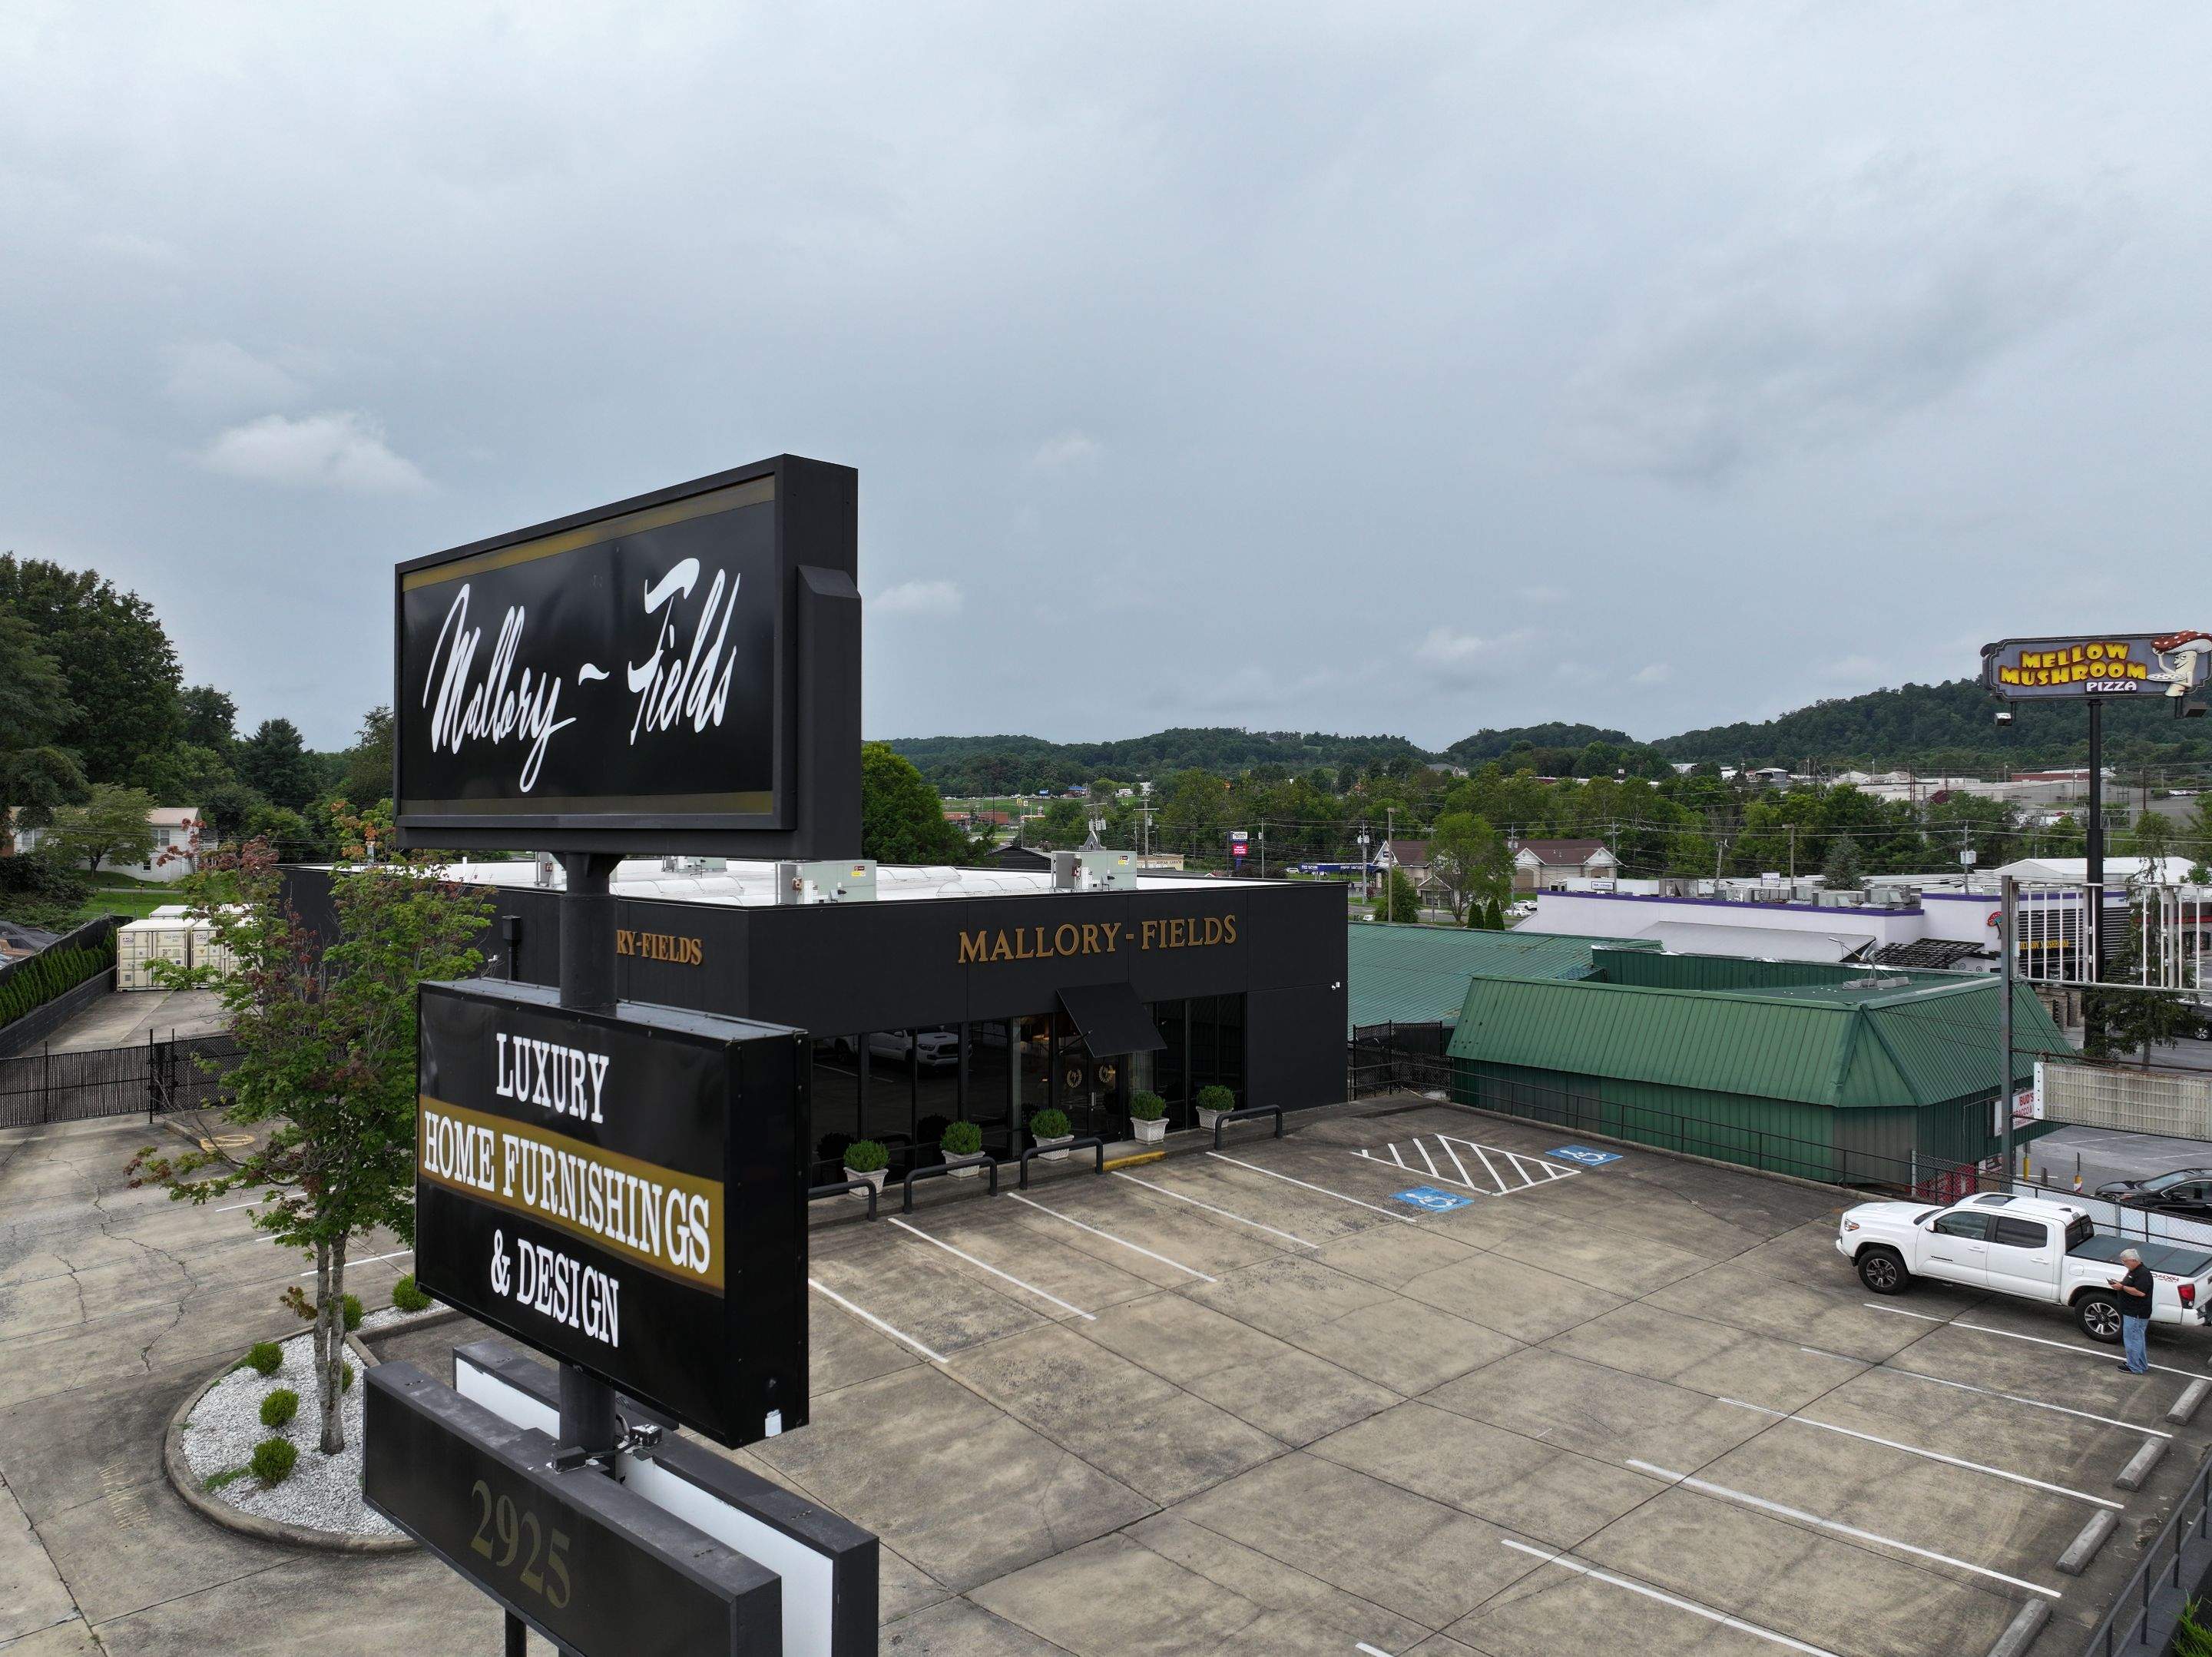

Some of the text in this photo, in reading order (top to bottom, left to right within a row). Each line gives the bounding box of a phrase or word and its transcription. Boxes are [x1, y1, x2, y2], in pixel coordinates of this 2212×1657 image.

[423, 584, 576, 793] Mallory
[628, 558, 740, 745] Fields
[2000, 662, 2147, 686] MUSHROOM
[2022, 643, 2129, 668] MELLOW
[2086, 681, 2137, 691] PIZZA
[616, 930, 703, 966] RY-FIELDS
[496, 1033, 609, 1123] LUXURY
[423, 1111, 710, 1274] HOME FURNISHINGS
[491, 1229, 619, 1347] & DESIGN
[471, 1480, 571, 1609] 2925
